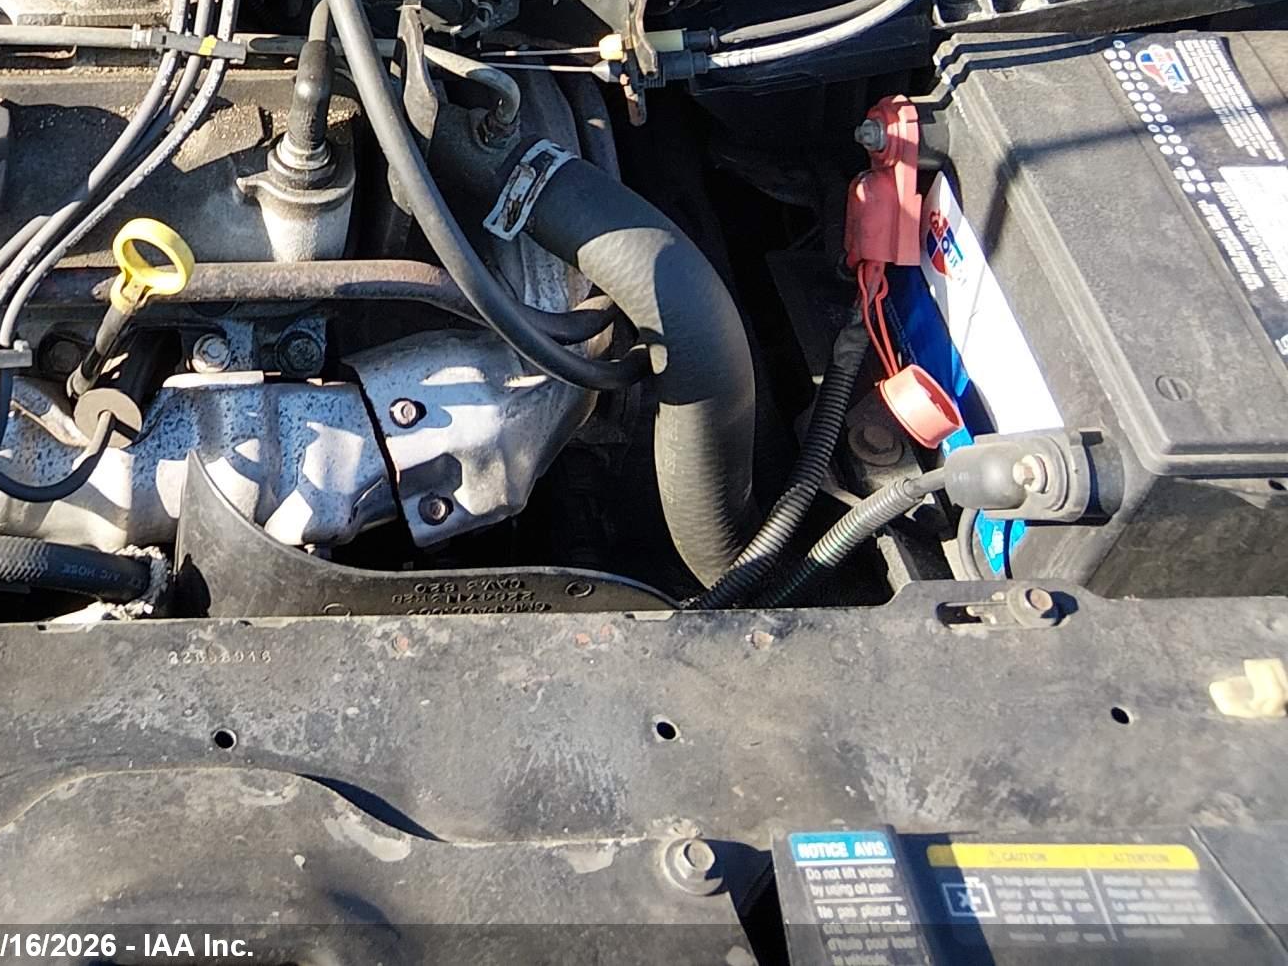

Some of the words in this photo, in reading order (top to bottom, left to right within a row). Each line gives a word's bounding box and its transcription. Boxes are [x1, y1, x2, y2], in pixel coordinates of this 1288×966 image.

[797, 842, 849, 858] NOTICE
[854, 841, 887, 857] AVIS
[1001, 852, 1048, 863] CAUTION
[1112, 853, 1170, 864] ATTENTION
[805, 867, 821, 880] Do
[823, 868, 841, 879] not
[858, 867, 893, 879] vehicle
[810, 884, 824, 897] by
[826, 883, 854, 897] using
